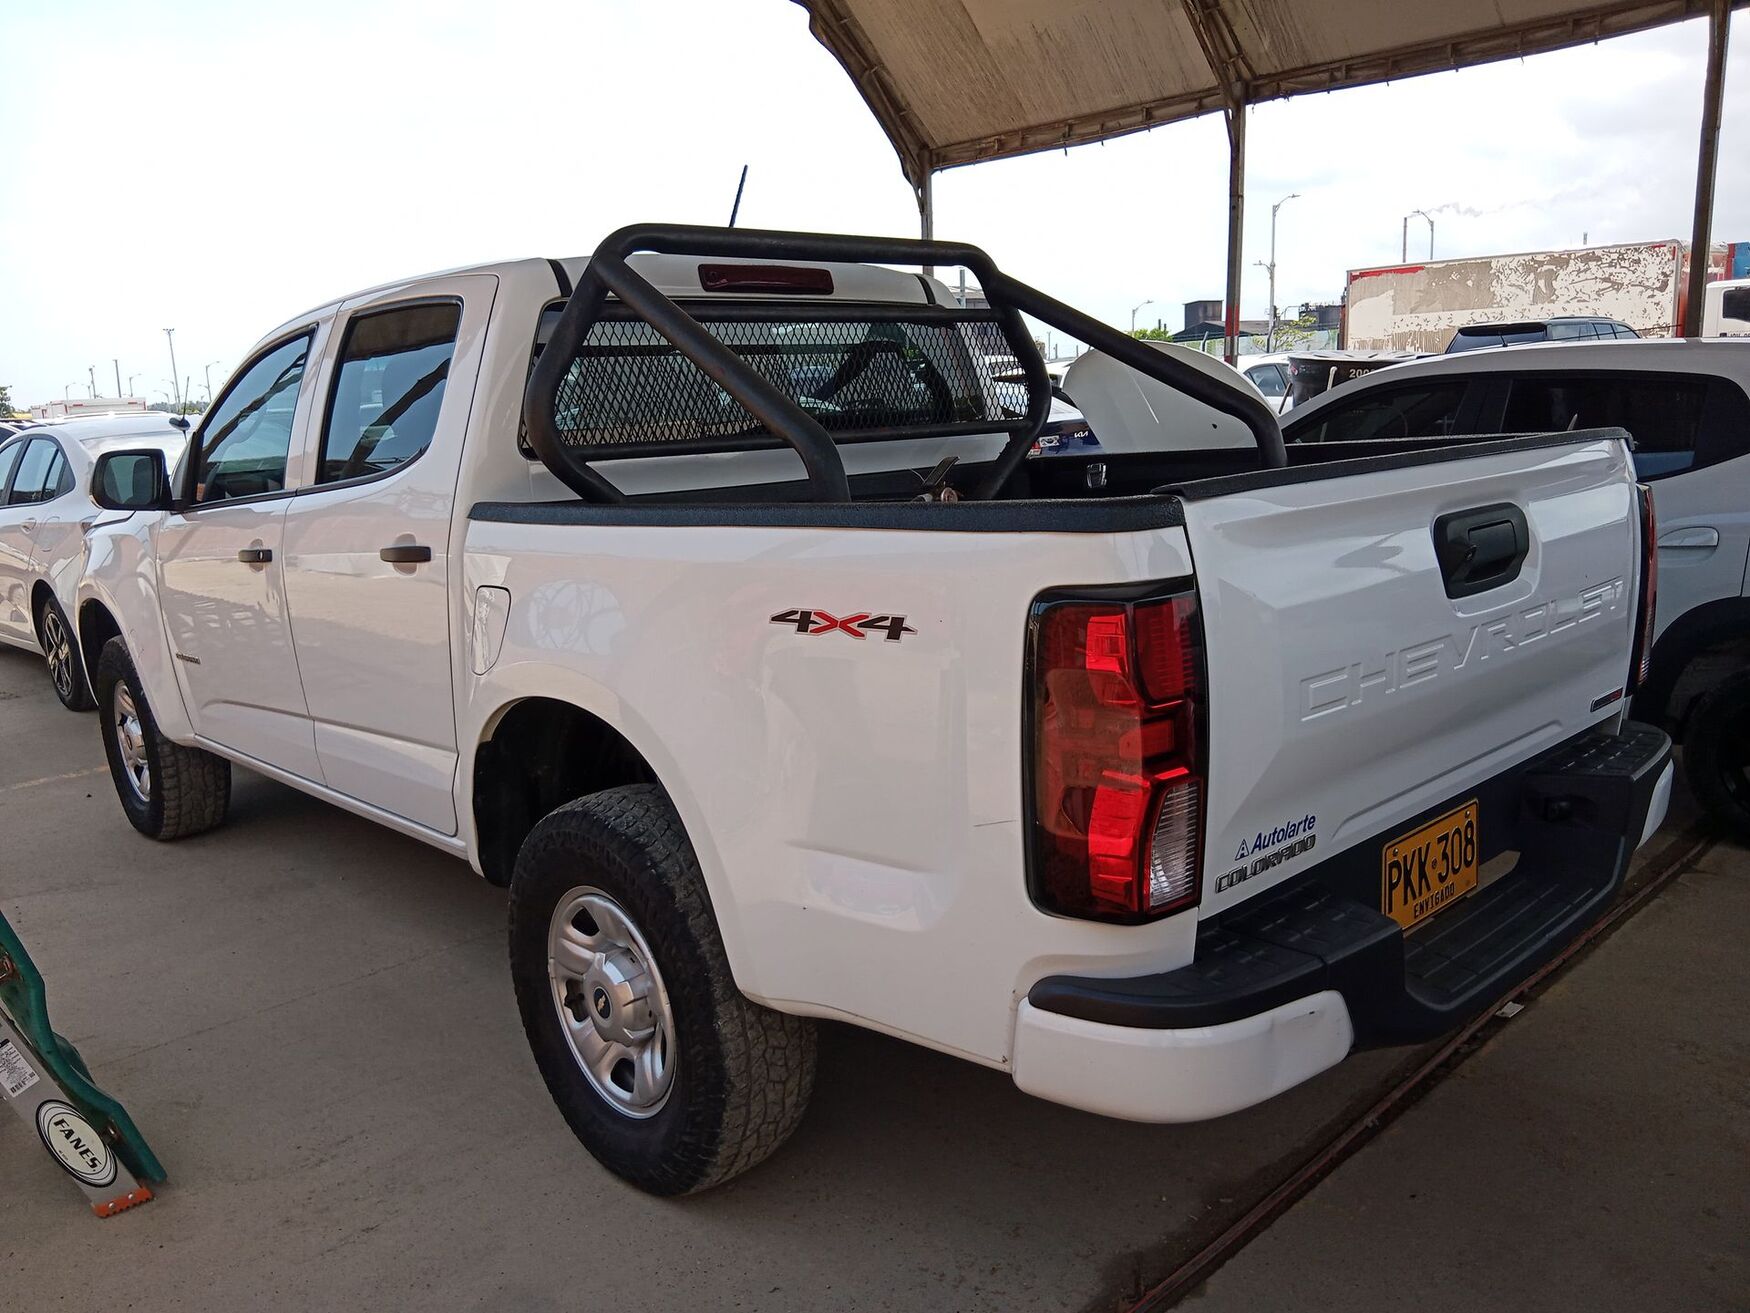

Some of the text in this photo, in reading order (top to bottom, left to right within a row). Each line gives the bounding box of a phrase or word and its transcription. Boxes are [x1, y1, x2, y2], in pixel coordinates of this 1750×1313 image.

[1074, 430, 1089, 438] KIA
[1301, 576, 1623, 721] CHEVROLET
[1250, 814, 1316, 854] Autolarte
[1214, 833, 1317, 894] COLORADO
[1413, 882, 1455, 918] ENVIGADO
